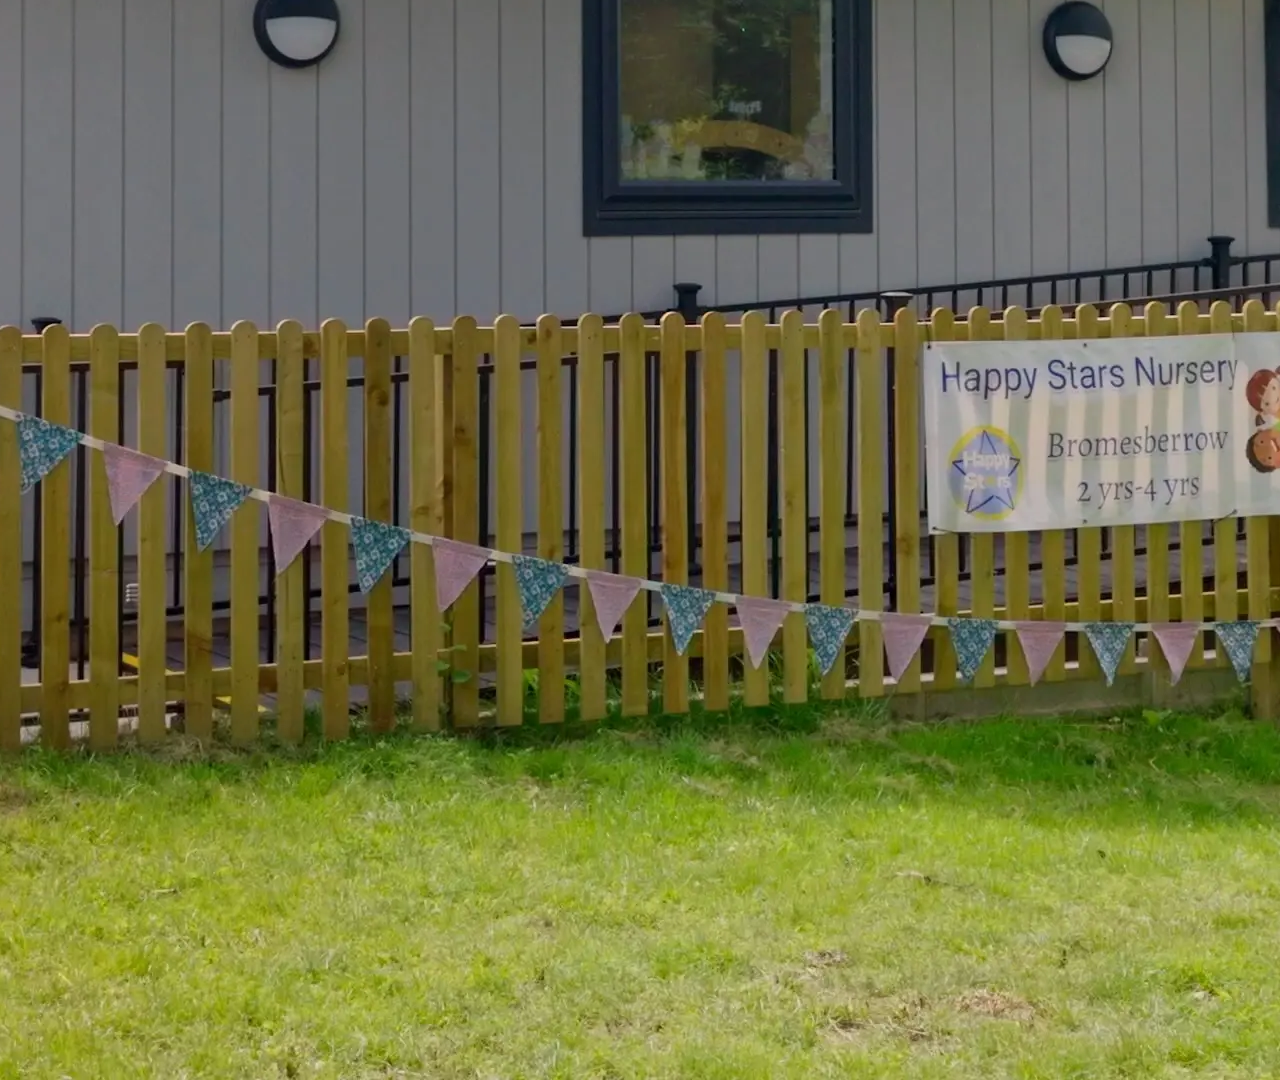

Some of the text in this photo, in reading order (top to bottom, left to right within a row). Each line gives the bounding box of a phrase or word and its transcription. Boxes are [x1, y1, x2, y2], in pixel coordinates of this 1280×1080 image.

[941, 356, 1238, 400] Happy Stars Nursery
[1047, 425, 1229, 459] Bromesberrow
[963, 451, 1011, 471] Happy
[1077, 481, 1092, 502] 2
[1163, 476, 1200, 506] yrs
